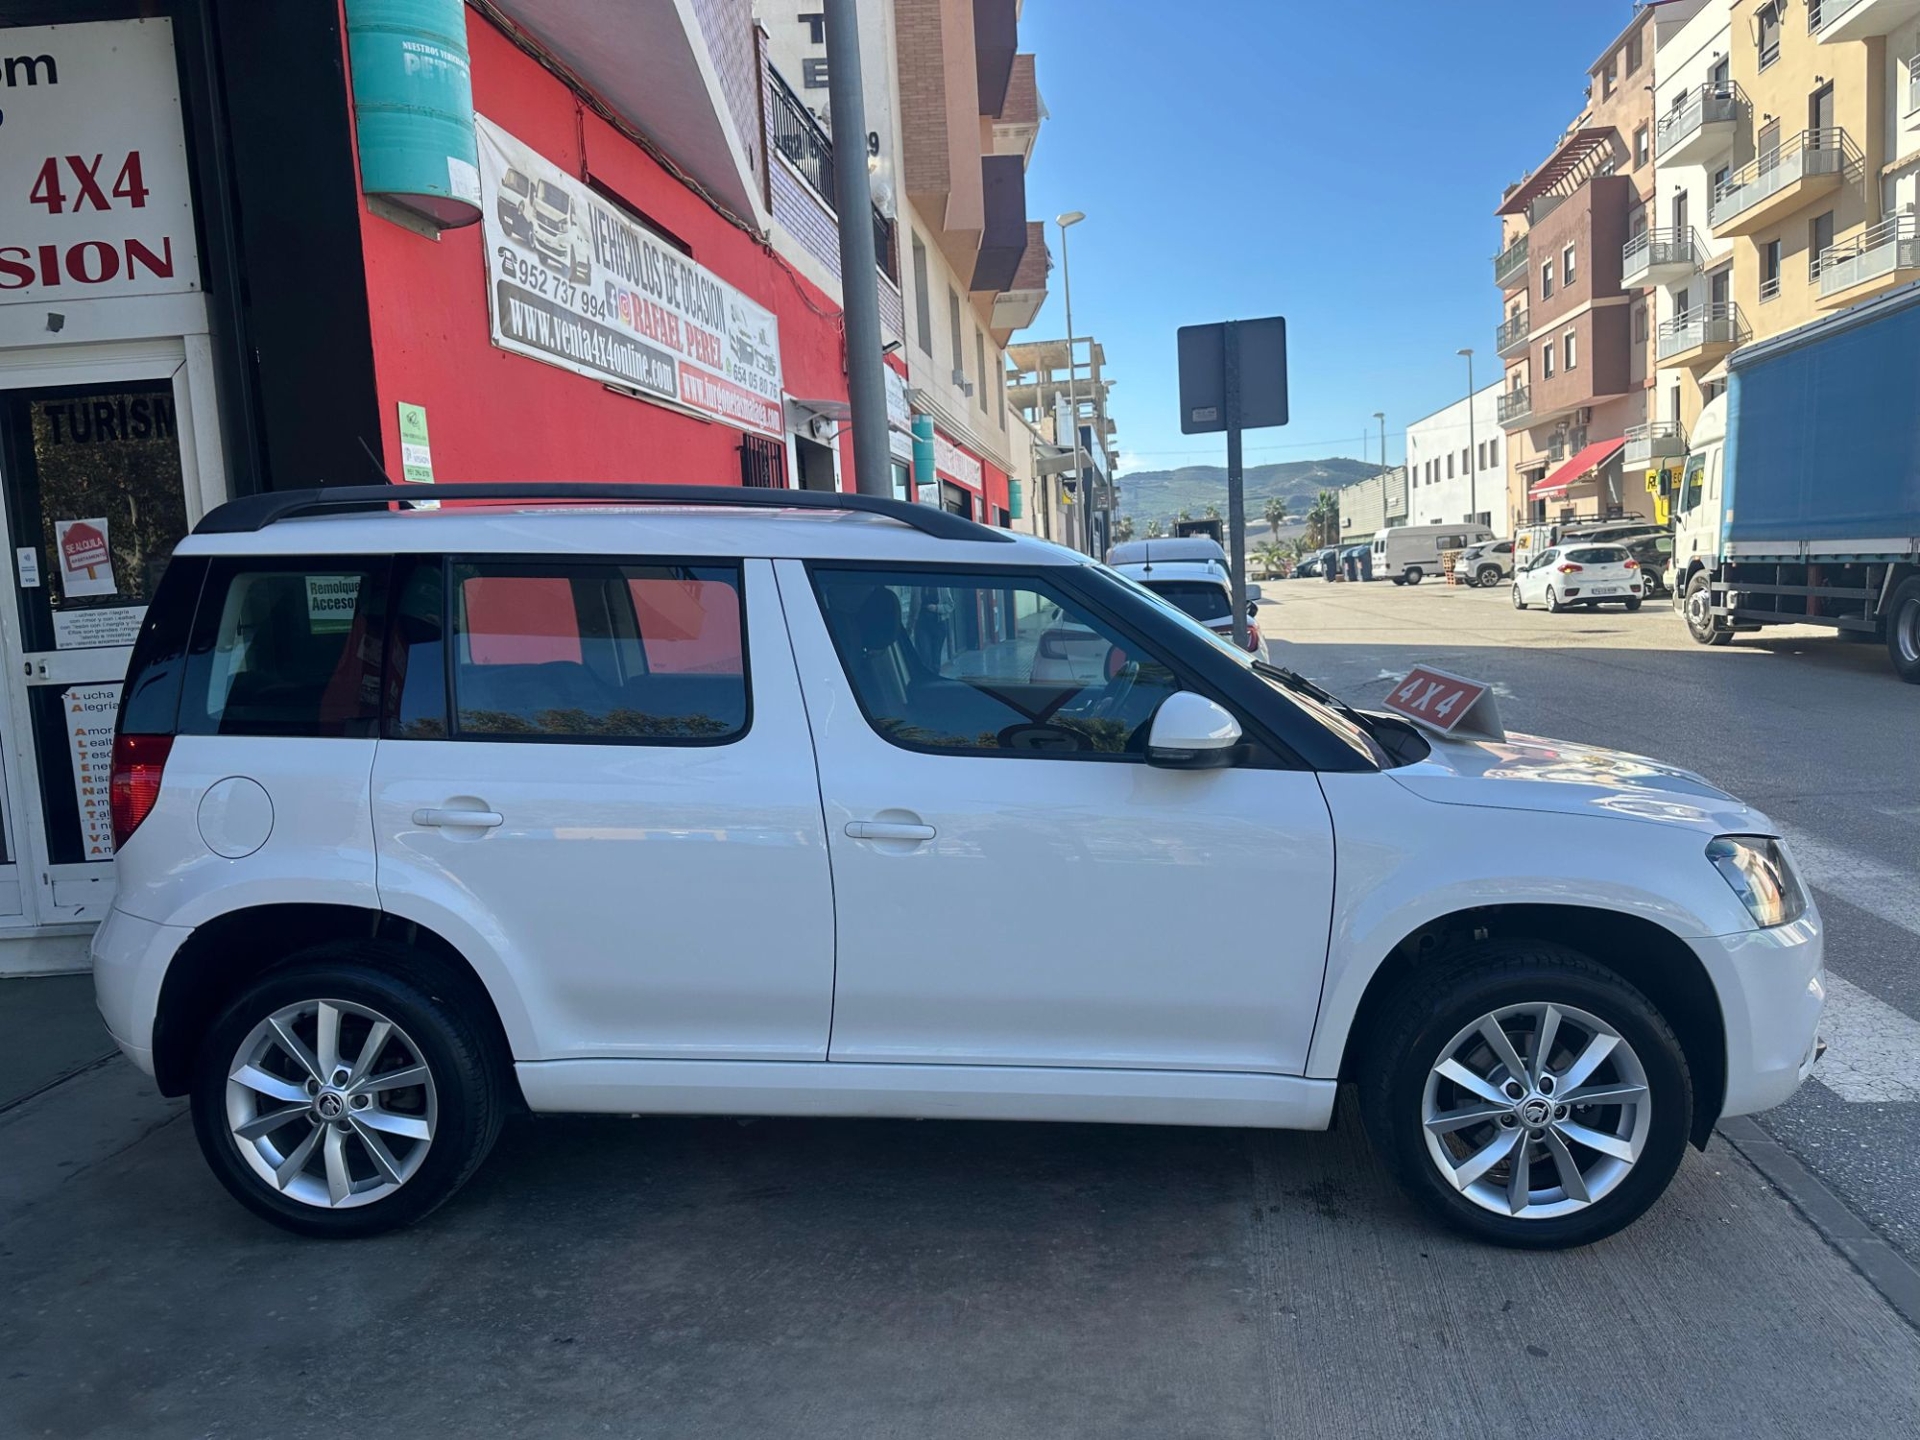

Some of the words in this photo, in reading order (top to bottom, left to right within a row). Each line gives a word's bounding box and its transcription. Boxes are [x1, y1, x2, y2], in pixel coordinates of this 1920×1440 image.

[864, 131, 880, 157] 9
[29, 151, 149, 214] 4X4
[519, 260, 548, 295] 952
[553, 276, 577, 307] 737
[581, 291, 606, 321] 994
[588, 202, 662, 300] VEHICULOS
[661, 252, 681, 310] DE
[680, 262, 726, 334] OCASION
[509, 297, 674, 394] www.venta4x4online.com
[630, 291, 683, 353] RAFAEL
[684, 320, 723, 371] PEREZ
[733, 363, 747, 384] 654
[748, 371, 758, 390] 05
[759, 377, 768, 395] 80
[769, 381, 778, 399] 76
[312, 597, 357, 611] Acceso
[1398, 677, 1464, 719] 4X4
